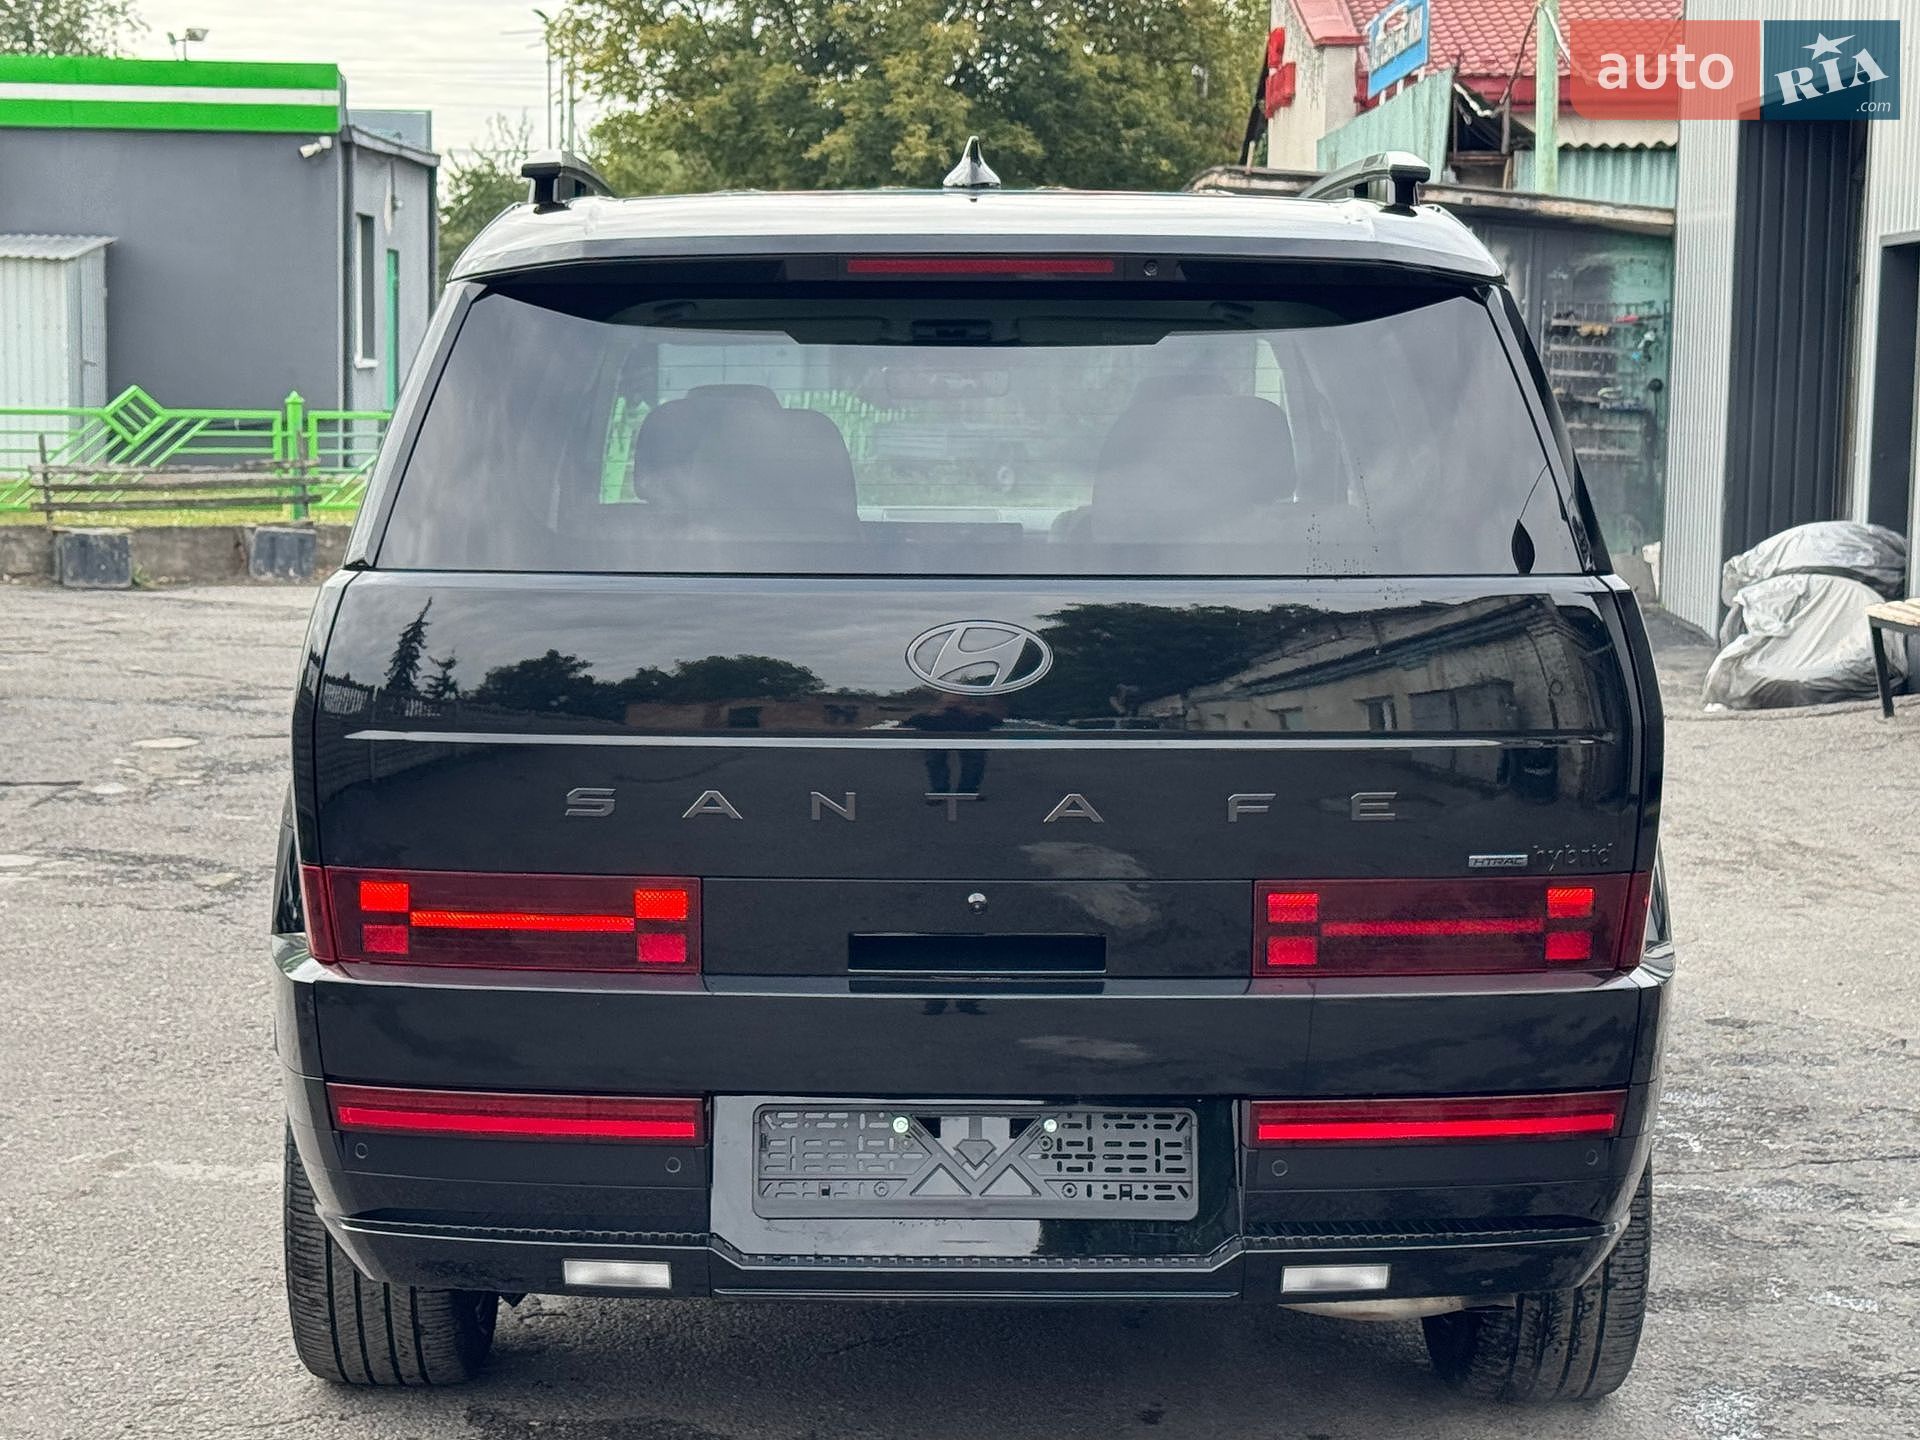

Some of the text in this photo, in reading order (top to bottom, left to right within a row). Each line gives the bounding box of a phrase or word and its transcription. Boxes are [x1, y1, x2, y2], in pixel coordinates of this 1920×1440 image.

[565, 787, 1398, 823] SANTA FE
[1533, 842, 1613, 872] hybrid
